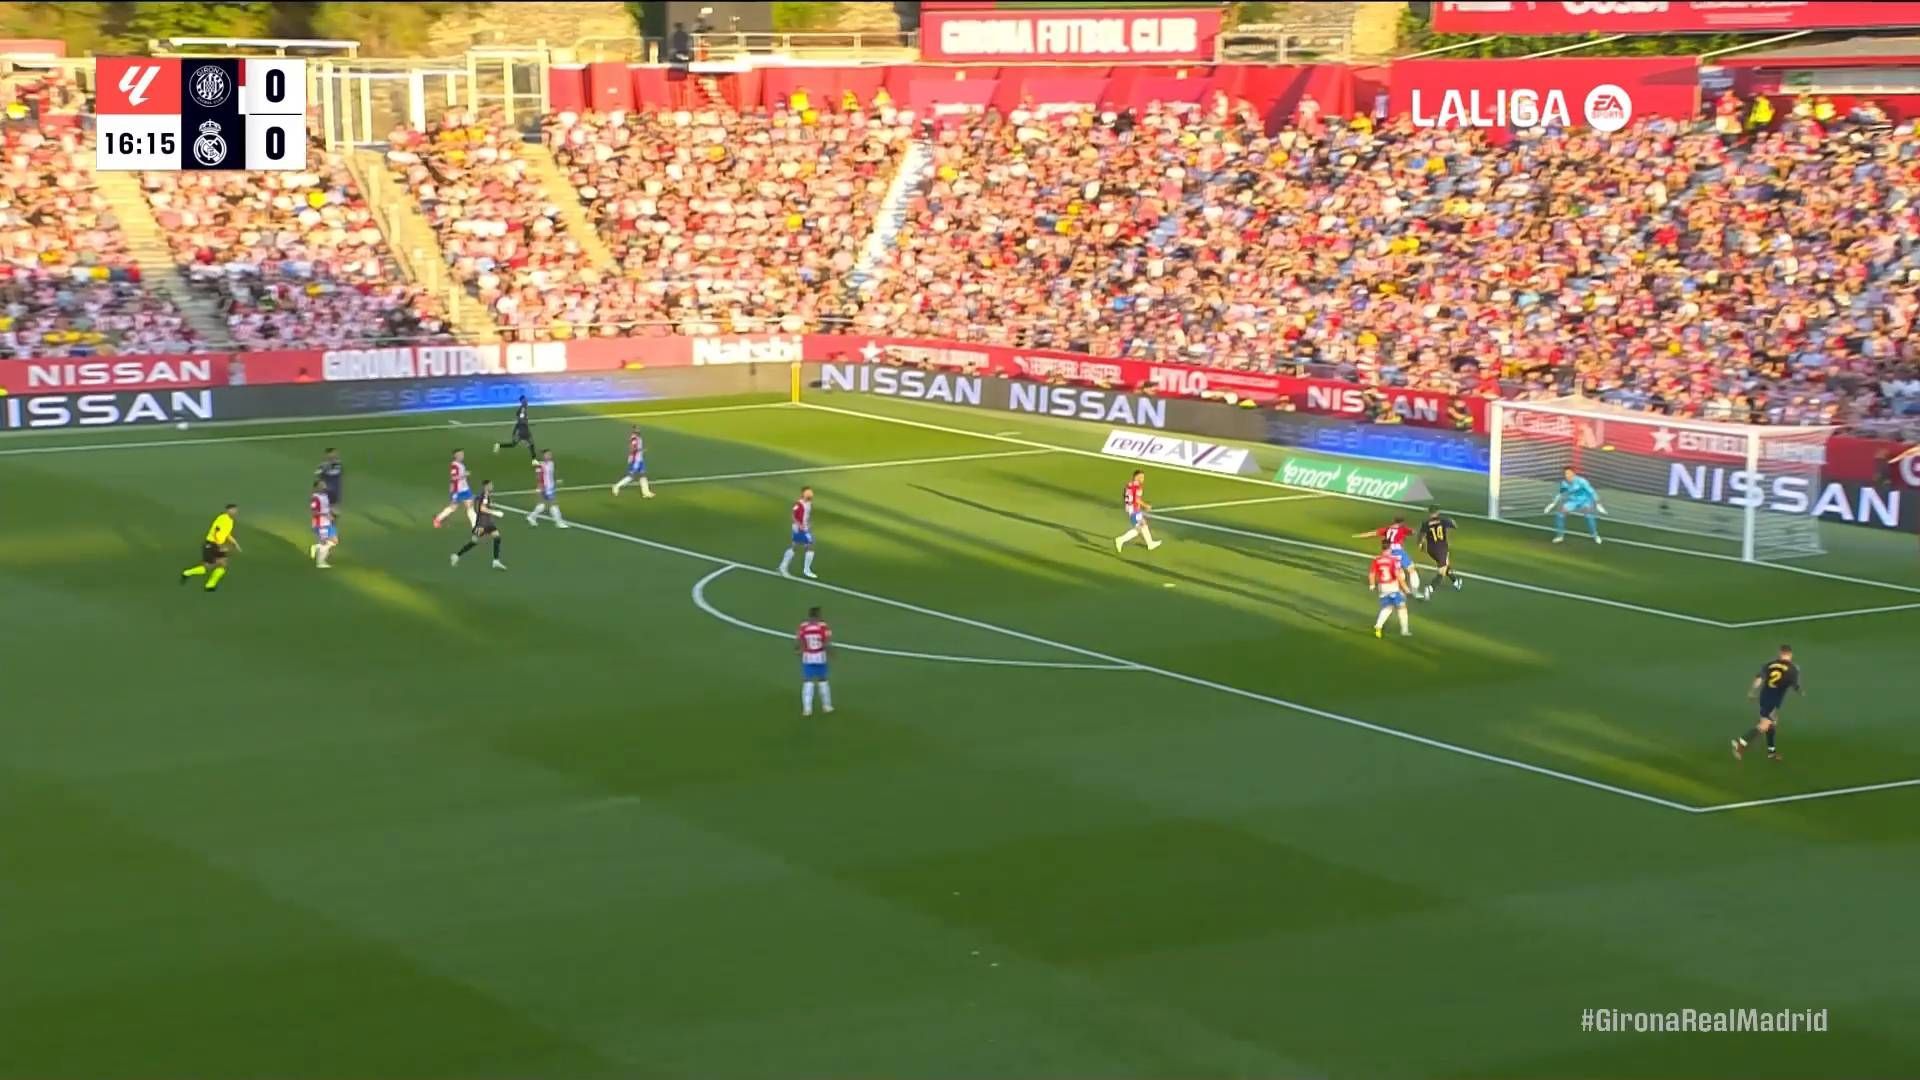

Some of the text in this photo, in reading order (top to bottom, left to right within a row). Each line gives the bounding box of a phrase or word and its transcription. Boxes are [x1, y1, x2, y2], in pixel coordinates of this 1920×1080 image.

[27, 360, 211, 387] NISSAN
[821, 364, 982, 404] NISSAN
[1009, 382, 1166, 428] NISSAN
[1306, 386, 1438, 421] NISAN
[1668, 463, 1900, 527] NISSAN
[1430, 525, 1444, 542] 14
[1379, 566, 1391, 581] 3
[1768, 670, 1782, 688] 2
